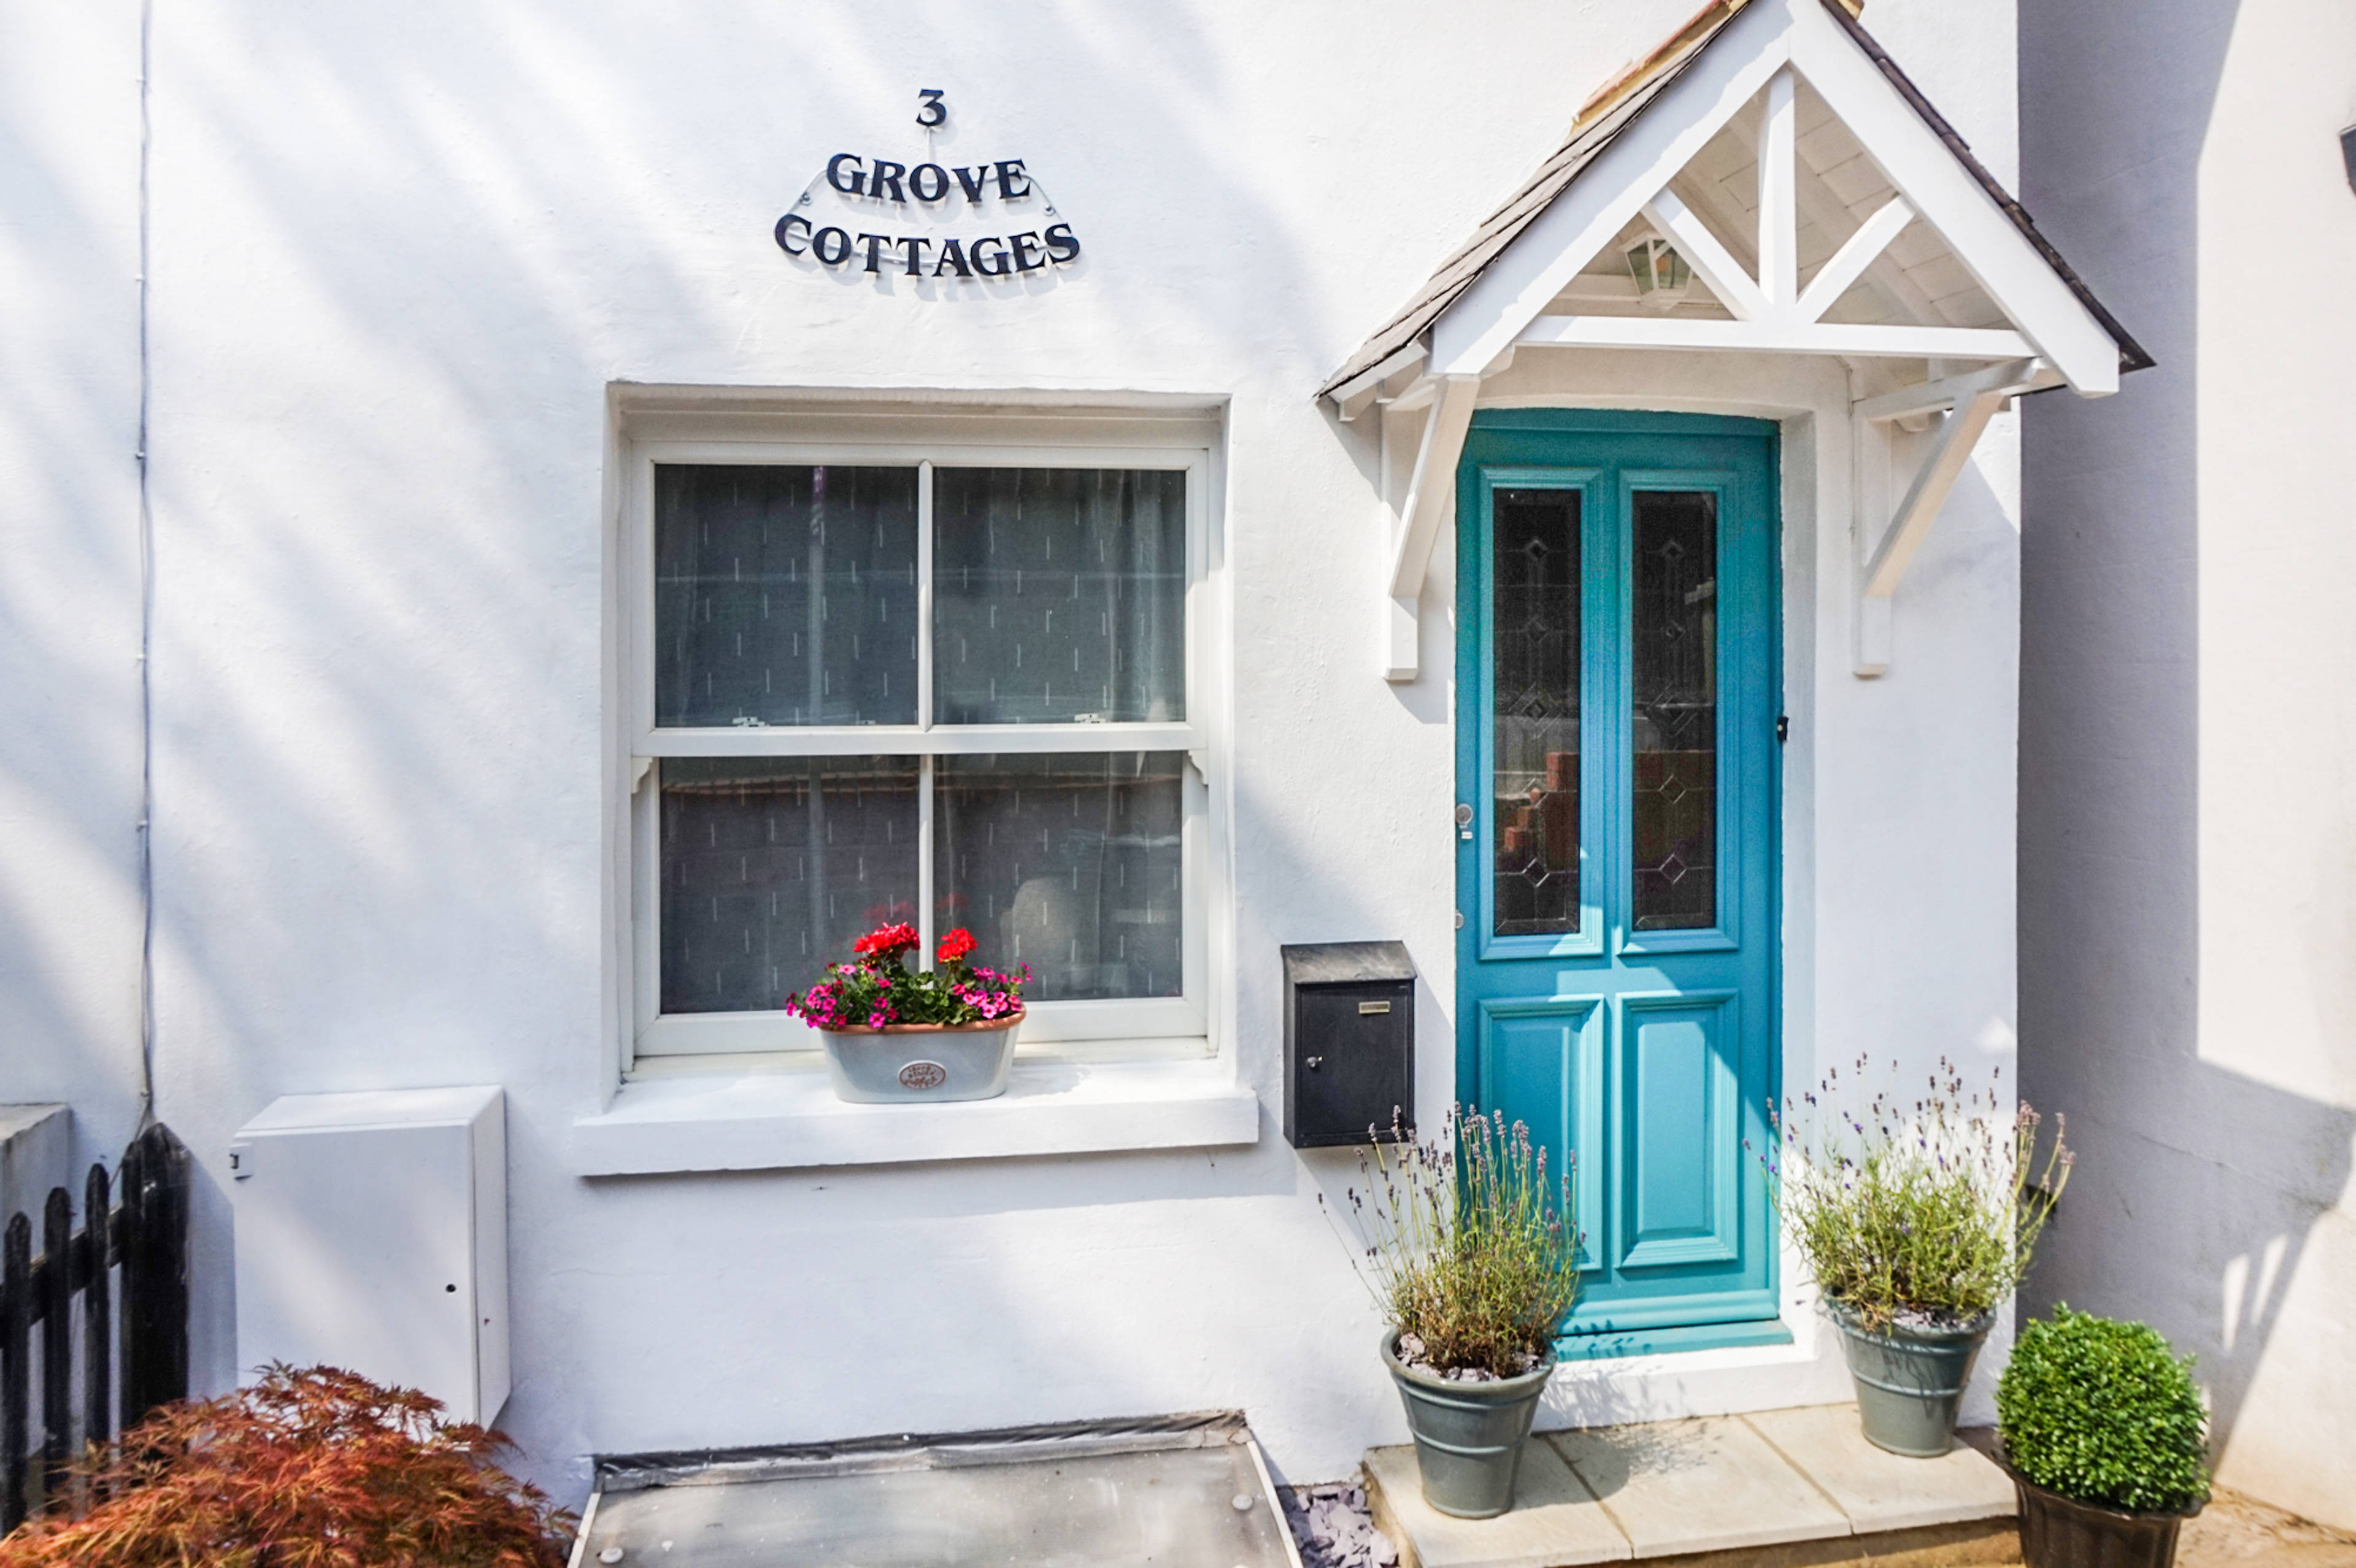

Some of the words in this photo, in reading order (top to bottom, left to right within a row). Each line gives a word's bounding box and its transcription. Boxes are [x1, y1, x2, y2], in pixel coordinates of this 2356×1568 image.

[916, 89, 947, 128] 3
[826, 153, 1031, 203] GROVE
[775, 214, 1080, 277] COTTAGES
